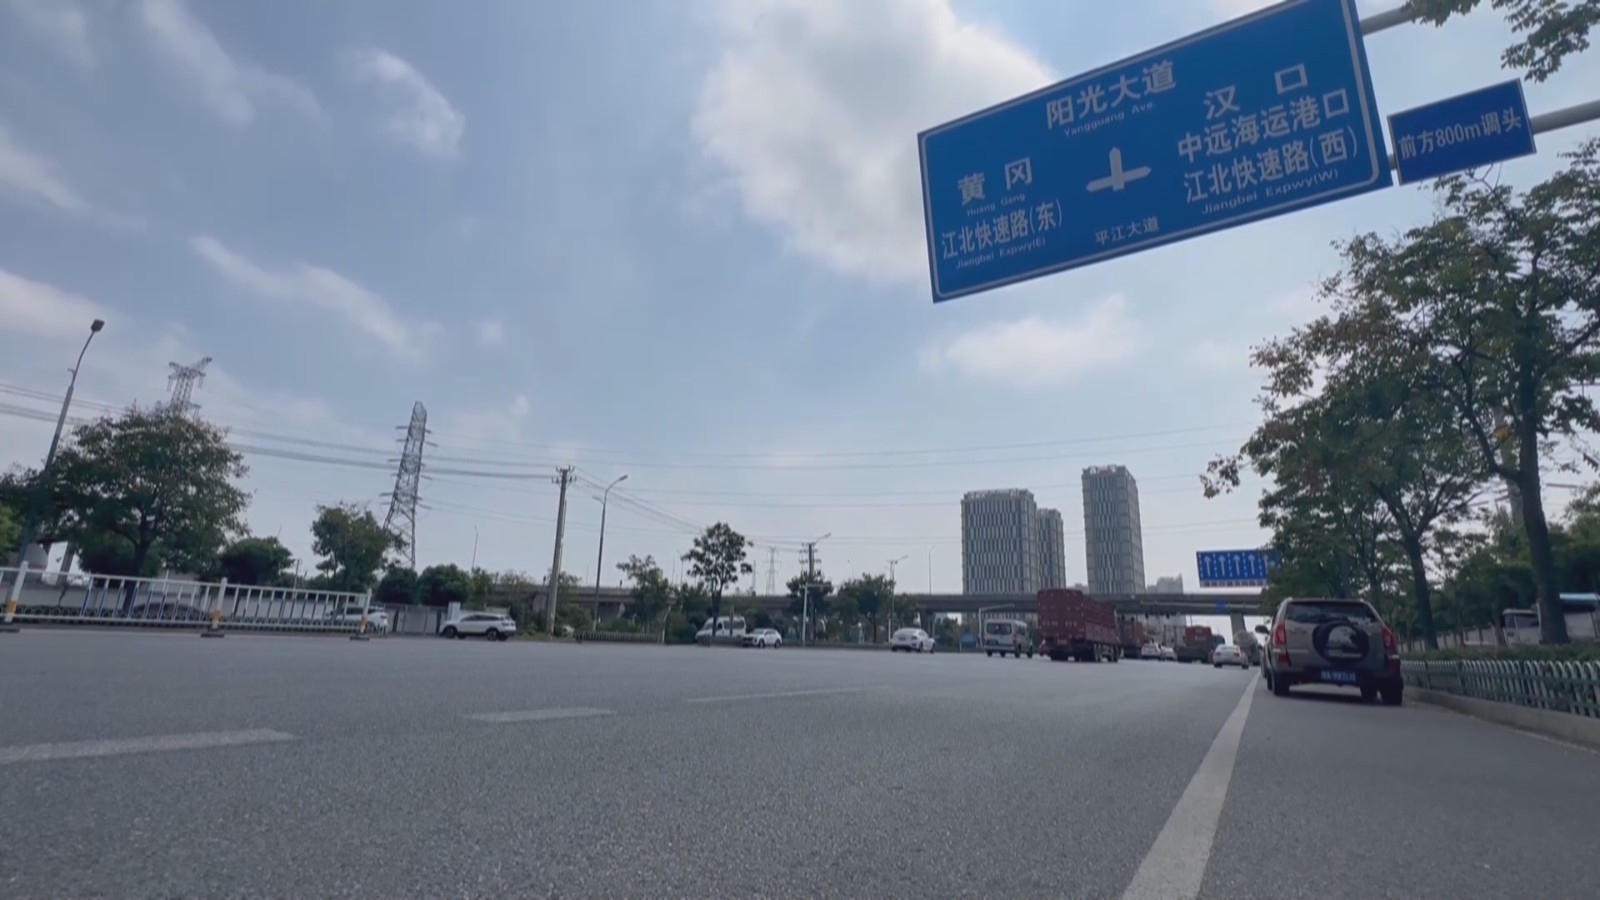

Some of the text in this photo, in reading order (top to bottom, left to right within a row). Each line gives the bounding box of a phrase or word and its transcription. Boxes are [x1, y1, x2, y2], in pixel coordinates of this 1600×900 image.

[1046, 60, 1177, 130] 阳光大道
[1064, 111, 1125, 137] Yangguang
[1177, 88, 1350, 164] 中远海运港口
[1399, 106, 1522, 160] 前方800m调头
[957, 156, 1033, 205] 黄冈
[1184, 126, 1358, 203] 江北快速路(西)
[967, 193, 1026, 217] Huang Gang
[1201, 168, 1338, 215] Jiangbei Expwy(W)
[941, 198, 1063, 260] 江北快速路(东)
[1094, 216, 1160, 247] 平江大道
[955, 253, 995, 270] Jiangbei
